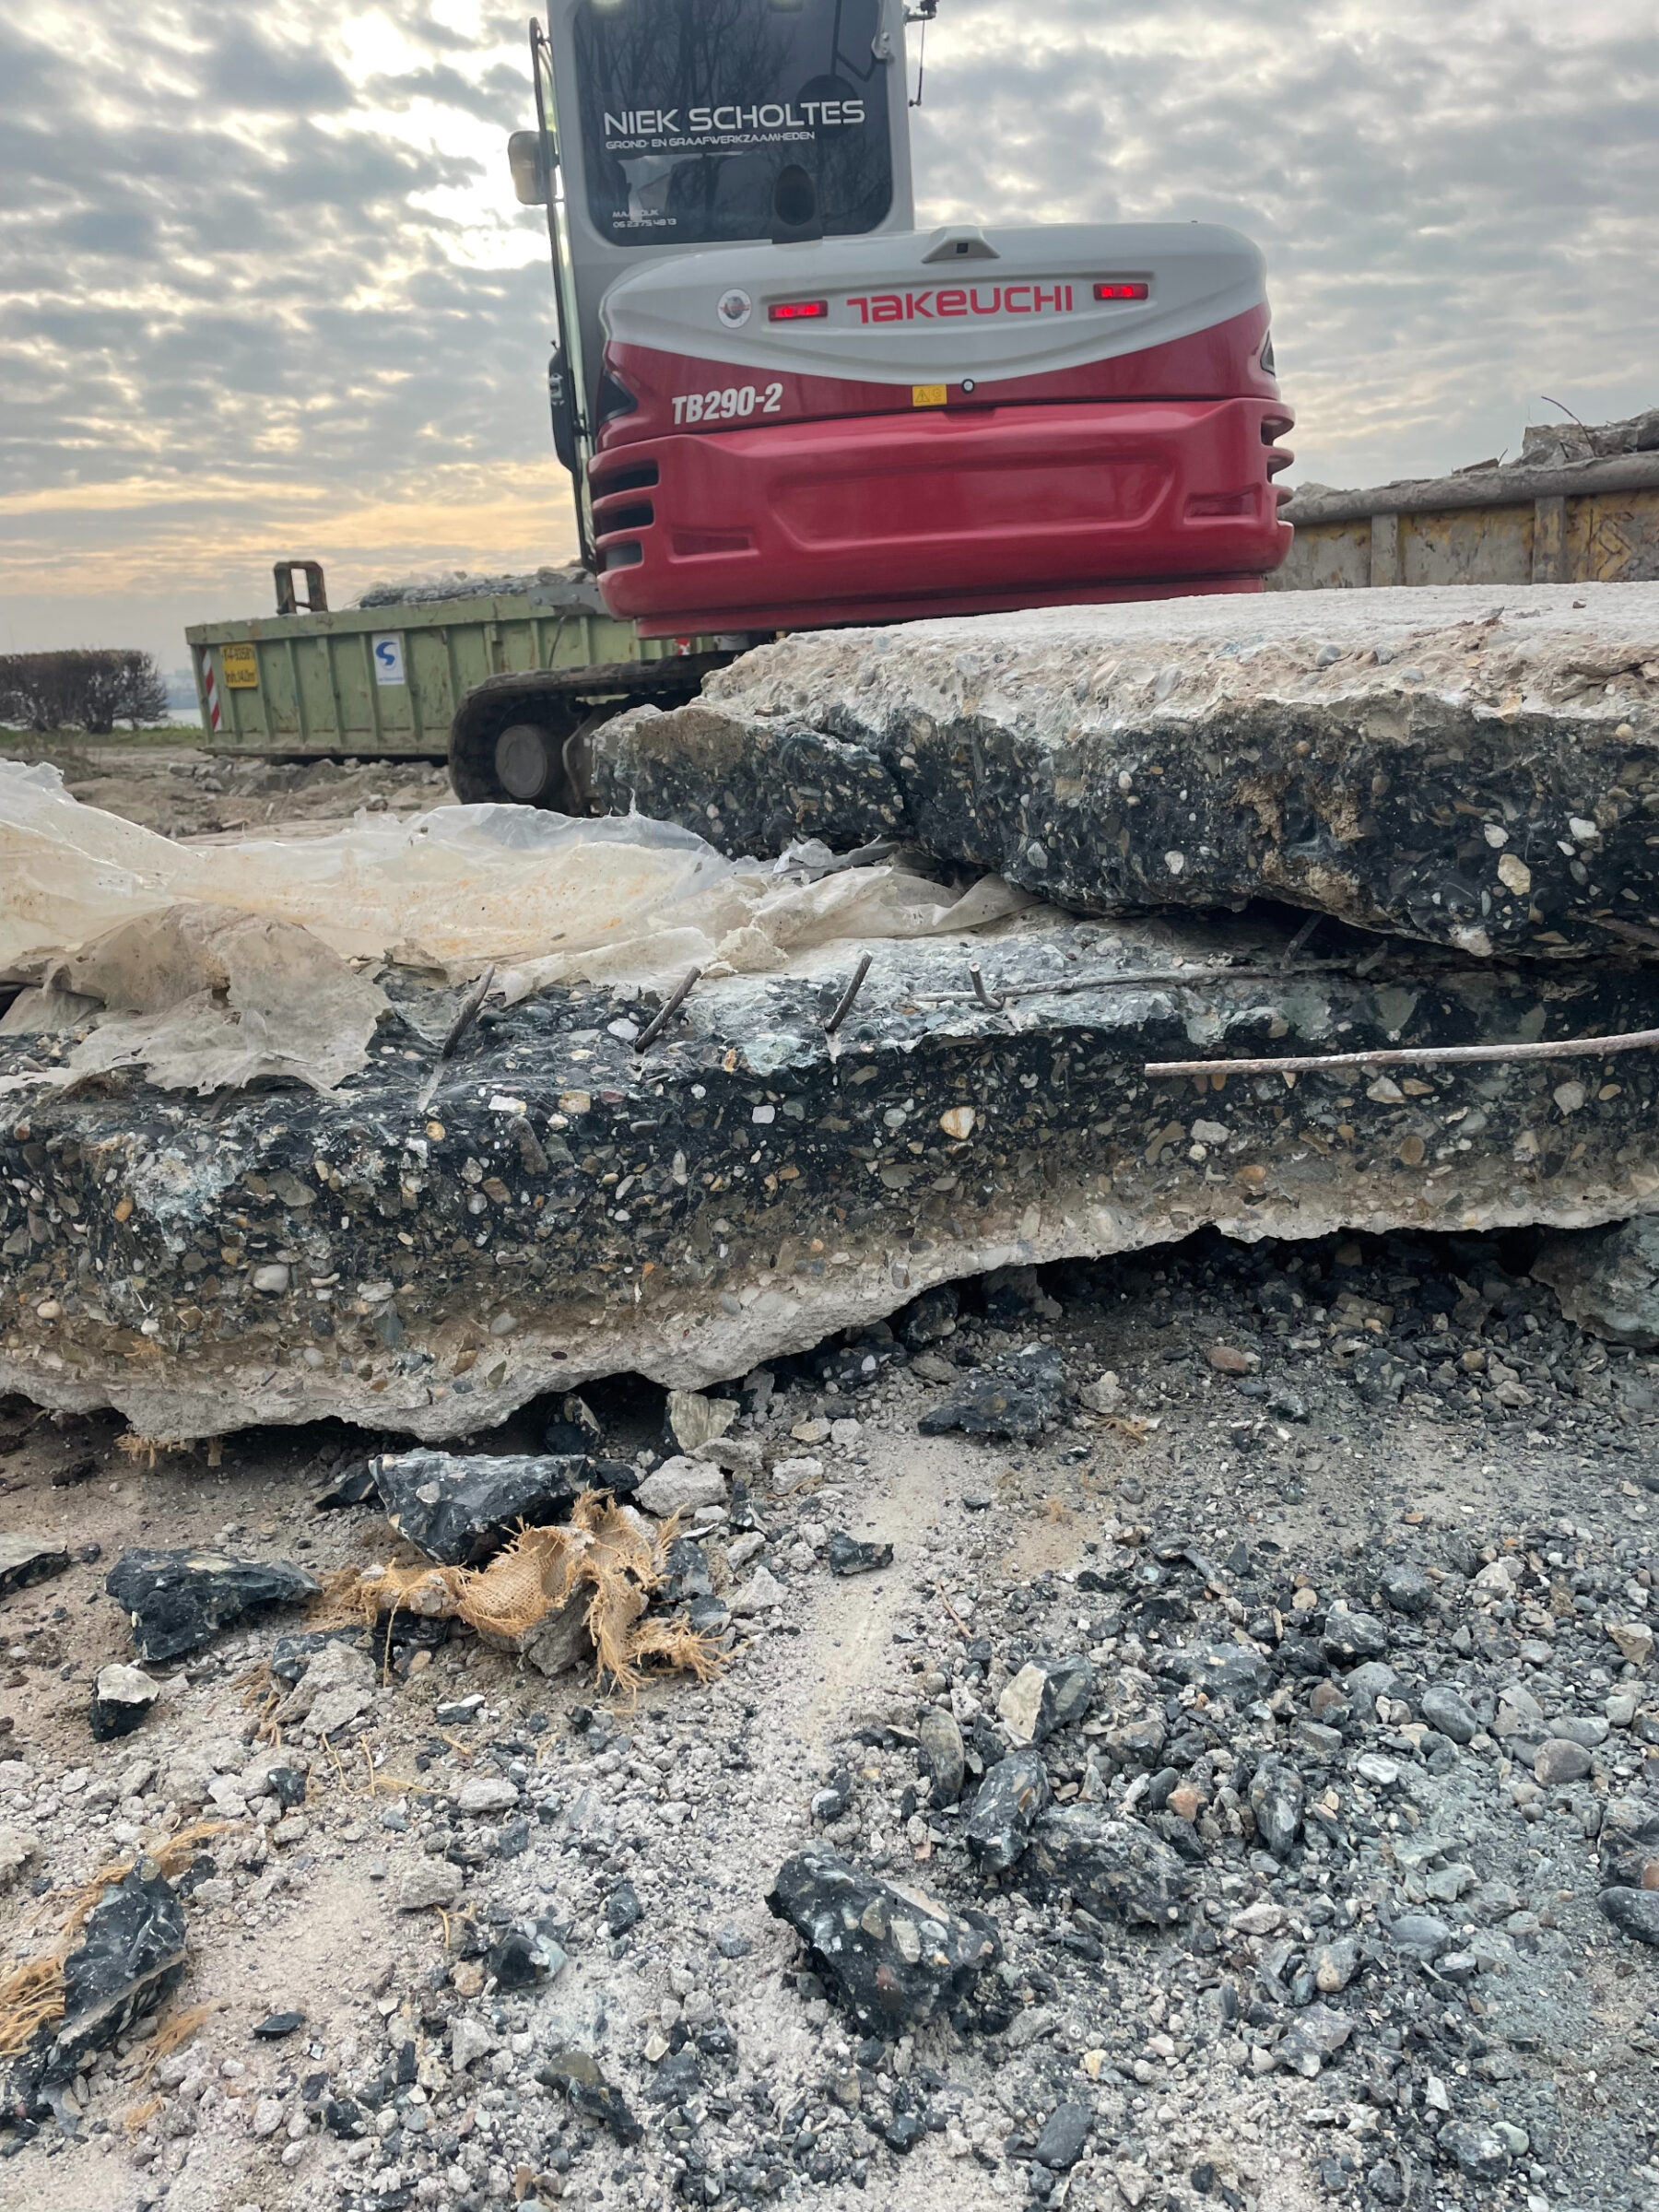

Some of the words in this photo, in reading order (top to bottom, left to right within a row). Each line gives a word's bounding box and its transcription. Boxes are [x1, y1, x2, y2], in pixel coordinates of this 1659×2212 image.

[604, 109, 680, 135] NIEK
[688, 100, 865, 131] SCHOLTES
[606, 139, 649, 149] GROND-
[651, 138, 667, 147] EN
[668, 131, 816, 147] GRAAFWERKZAAMHEDEN
[671, 382, 783, 425] TB290-2
